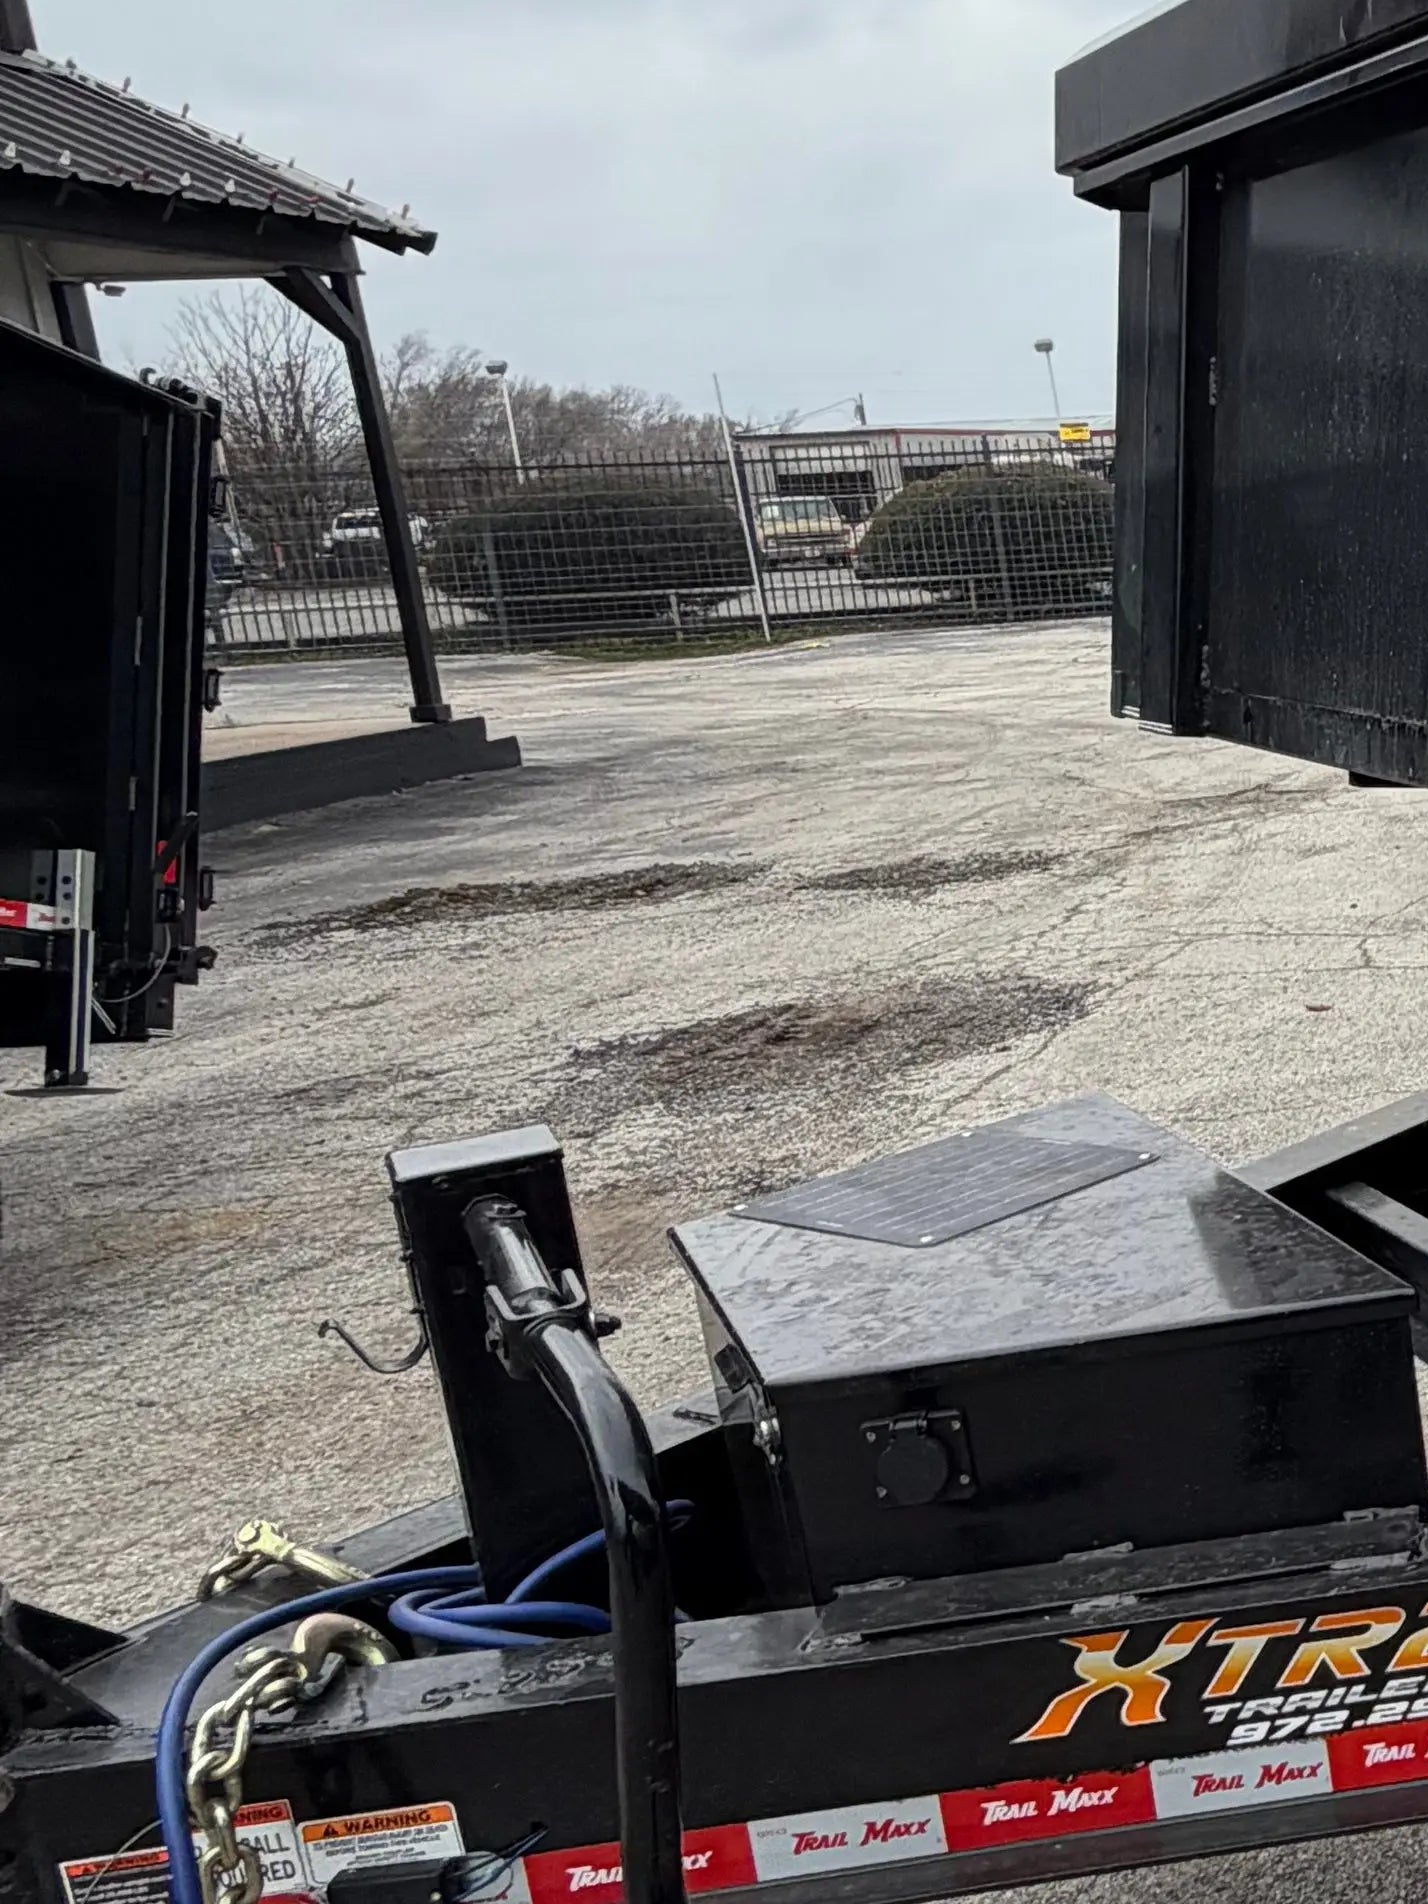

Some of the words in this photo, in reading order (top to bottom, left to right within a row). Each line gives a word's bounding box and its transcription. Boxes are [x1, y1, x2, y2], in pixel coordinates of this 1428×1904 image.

[1363, 1743, 1415, 1767] TRAIL
[1191, 1773, 1245, 1797] TRAIL
[1254, 1761, 1323, 1789] MAXX
[343, 1809, 432, 1837] WARNING
[981, 1799, 1038, 1827] TRAIL
[1047, 1786, 1119, 1816] MAXX
[791, 1831, 848, 1856] TRAIL
[859, 1818, 931, 1846] MAXX
